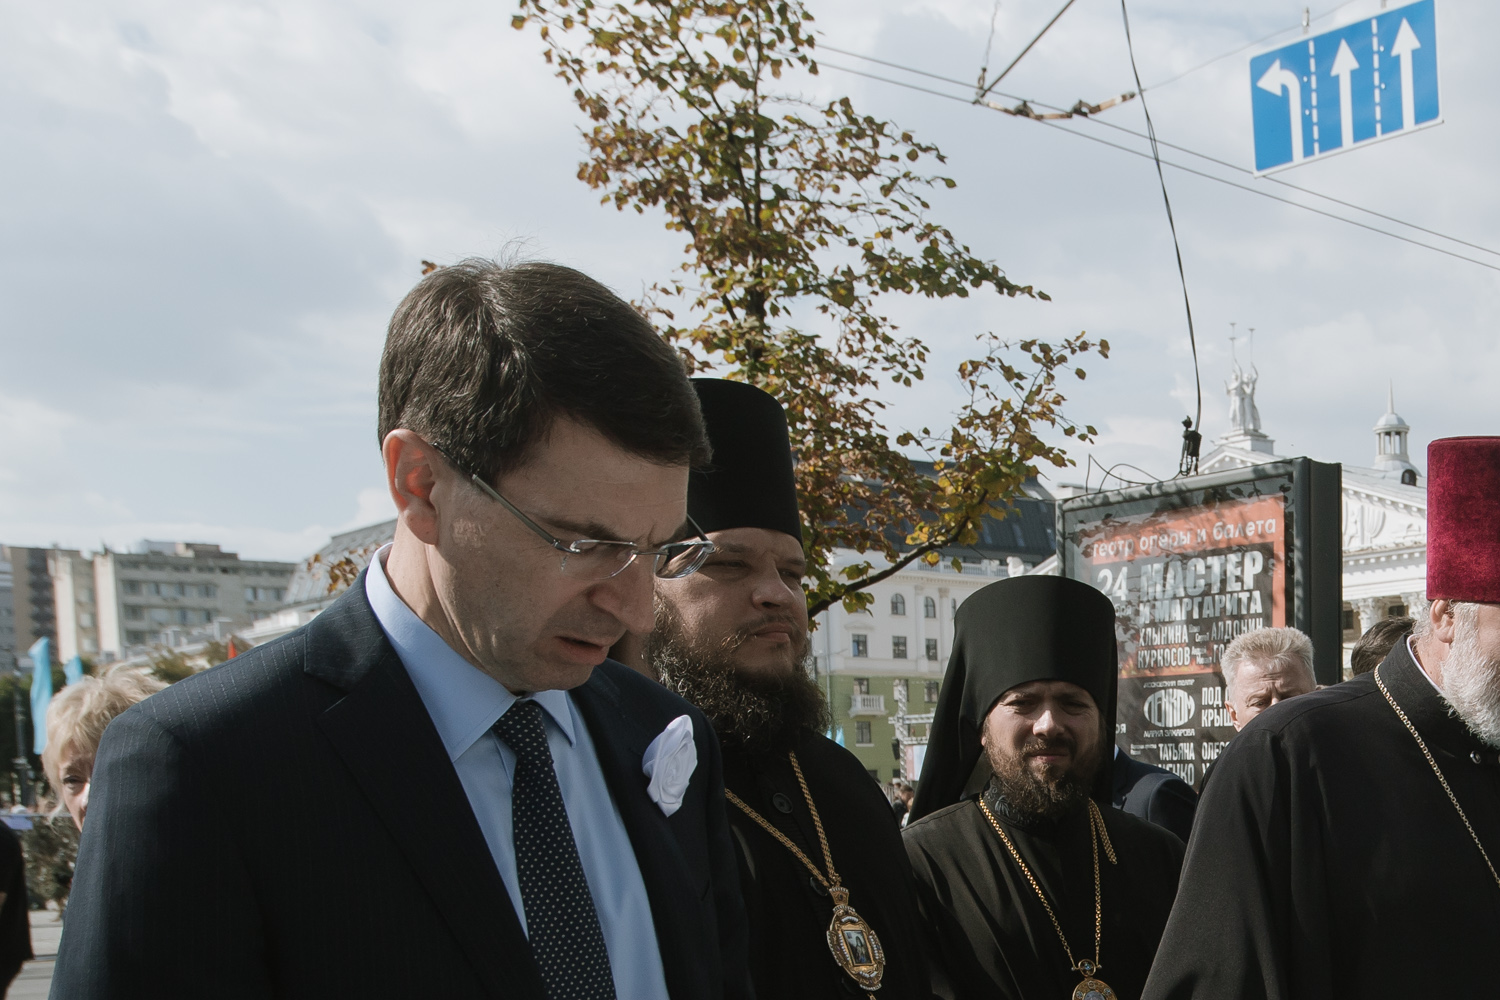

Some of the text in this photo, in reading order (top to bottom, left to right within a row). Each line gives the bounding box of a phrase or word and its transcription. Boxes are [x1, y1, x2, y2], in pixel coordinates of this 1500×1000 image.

[1093, 517, 1276, 558] театр оперы и балета
[1097, 566, 1128, 600] 24
[1140, 550, 1263, 600] МАСТЕР
[1139, 590, 1262, 624] И МАРГАРИТА
[1139, 625, 1188, 646] ХЛЫНИНА
[1211, 617, 1263, 642] АЛДОНИН
[1138, 647, 1191, 669] КУРНОСОВ
[1143, 688, 1195, 727] ЛЕНКОМ
[1201, 686, 1222, 707] ПОД
[1201, 708, 1234, 727] КРЫШ
[1158, 742, 1195, 760] ТАТЬЯНА
